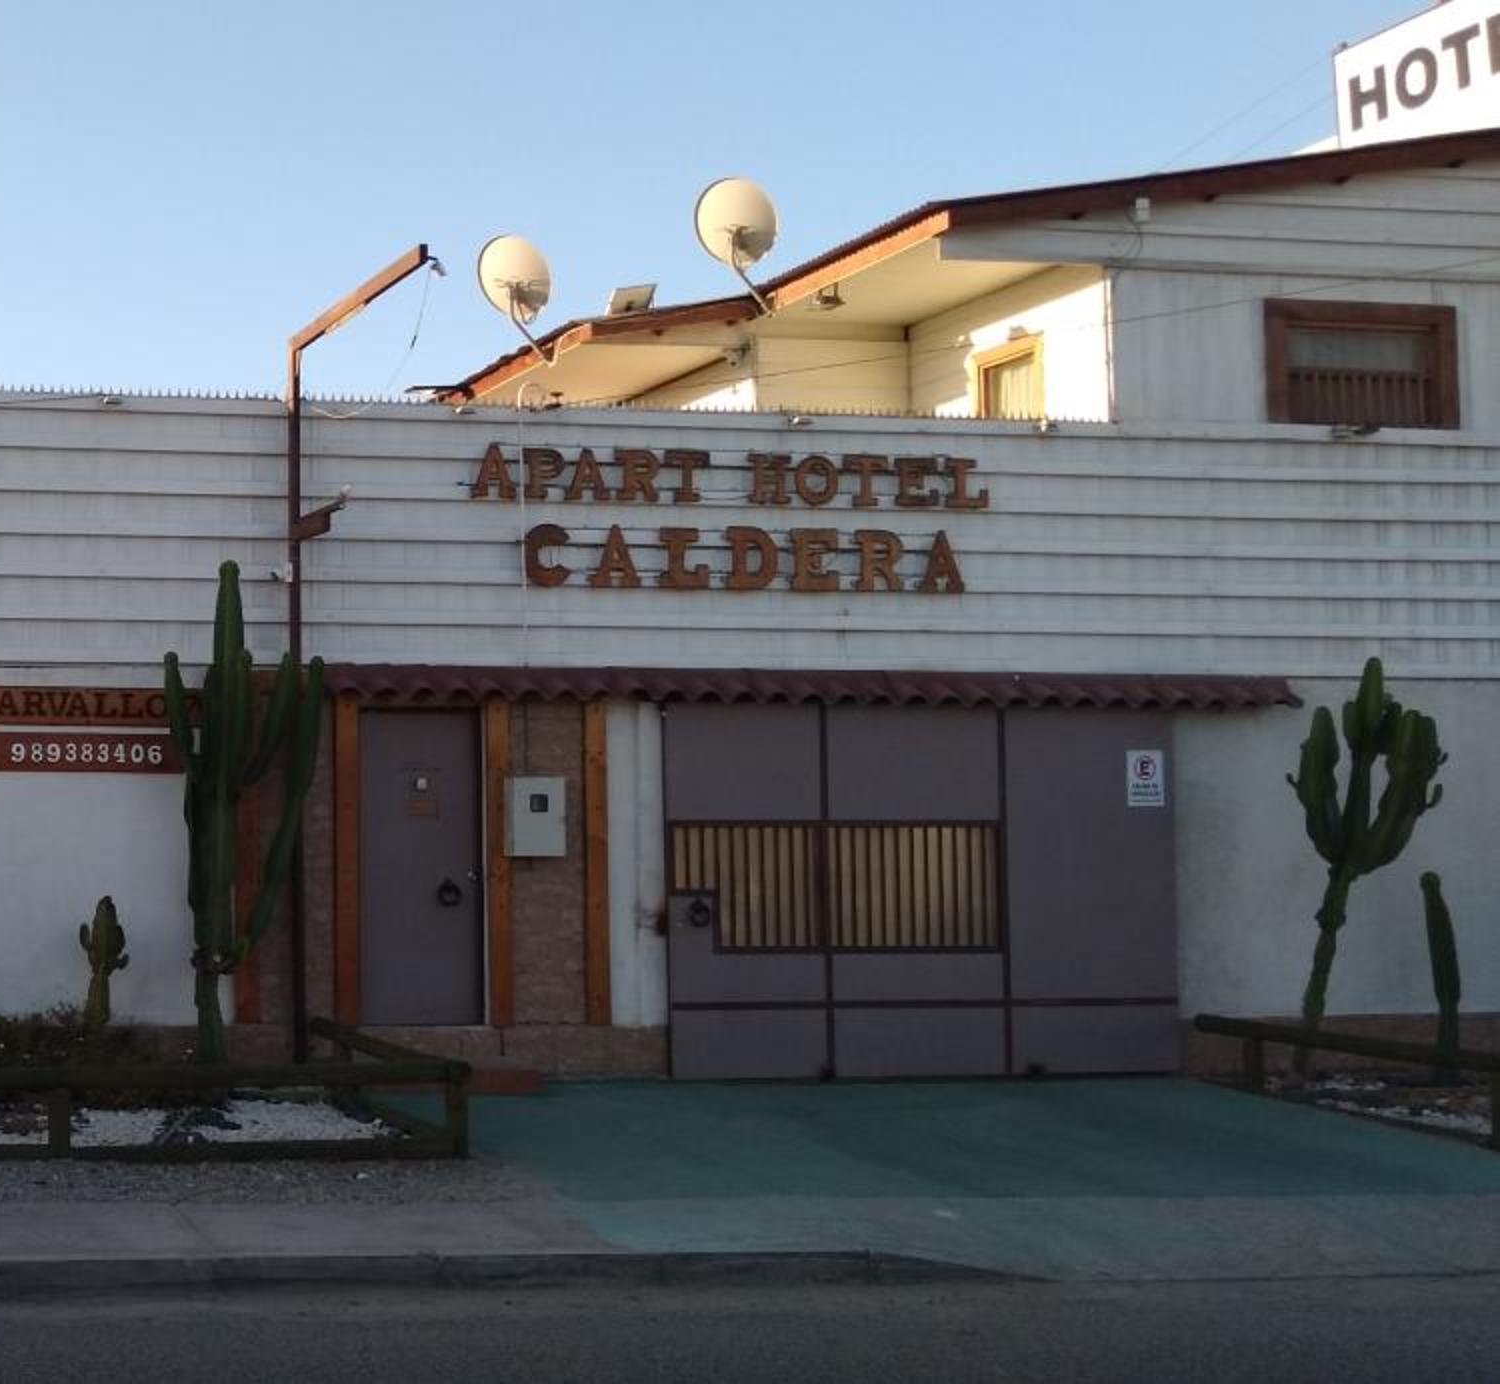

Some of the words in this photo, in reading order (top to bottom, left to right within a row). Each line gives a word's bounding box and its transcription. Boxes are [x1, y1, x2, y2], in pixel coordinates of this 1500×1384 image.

[470, 441, 710, 502] APART
[748, 453, 989, 508] HOTEL
[525, 523, 965, 594] CALDERA
[10, 743, 164, 765] 989383406
